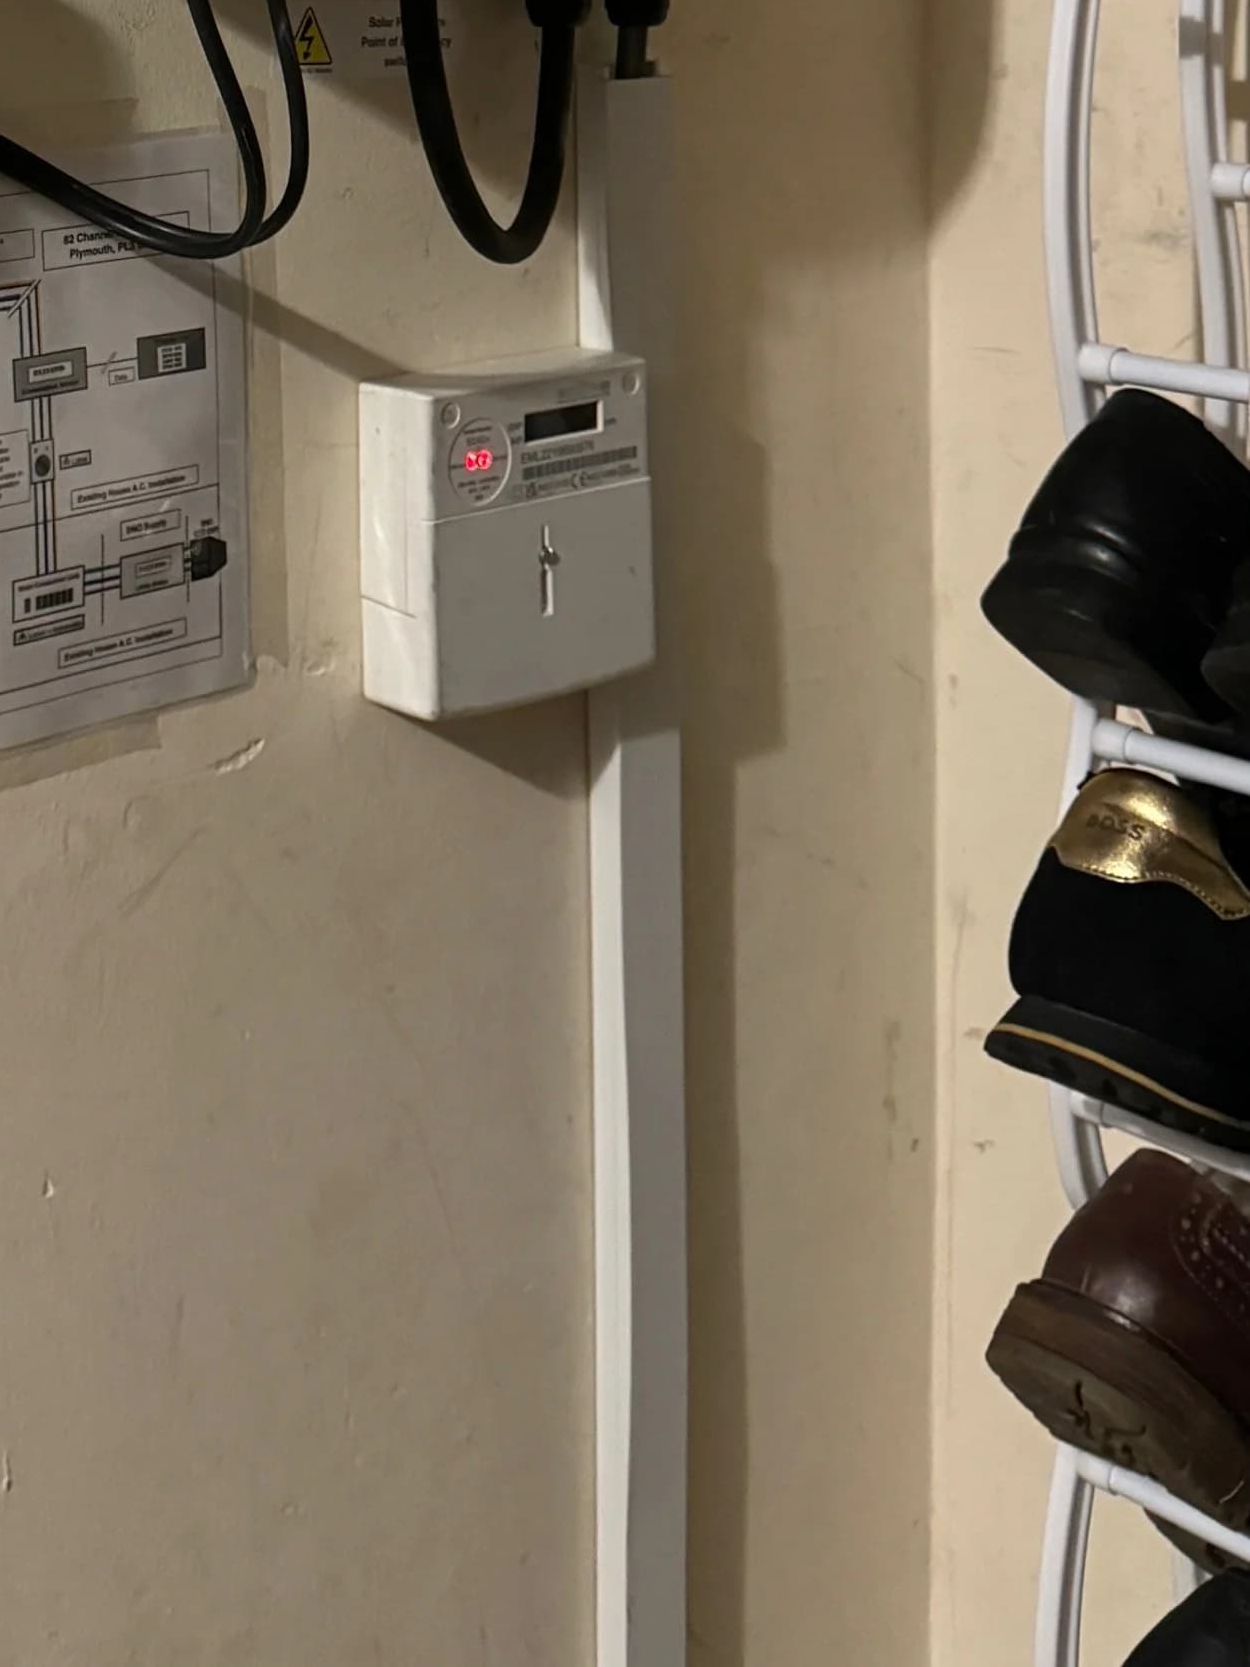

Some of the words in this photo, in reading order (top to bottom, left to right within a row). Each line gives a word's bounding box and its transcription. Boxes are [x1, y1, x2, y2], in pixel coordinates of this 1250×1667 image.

[368, 15, 394, 29] Solar
[360, 36, 386, 48] Point
[69, 245, 115, 260] Plymouth,
